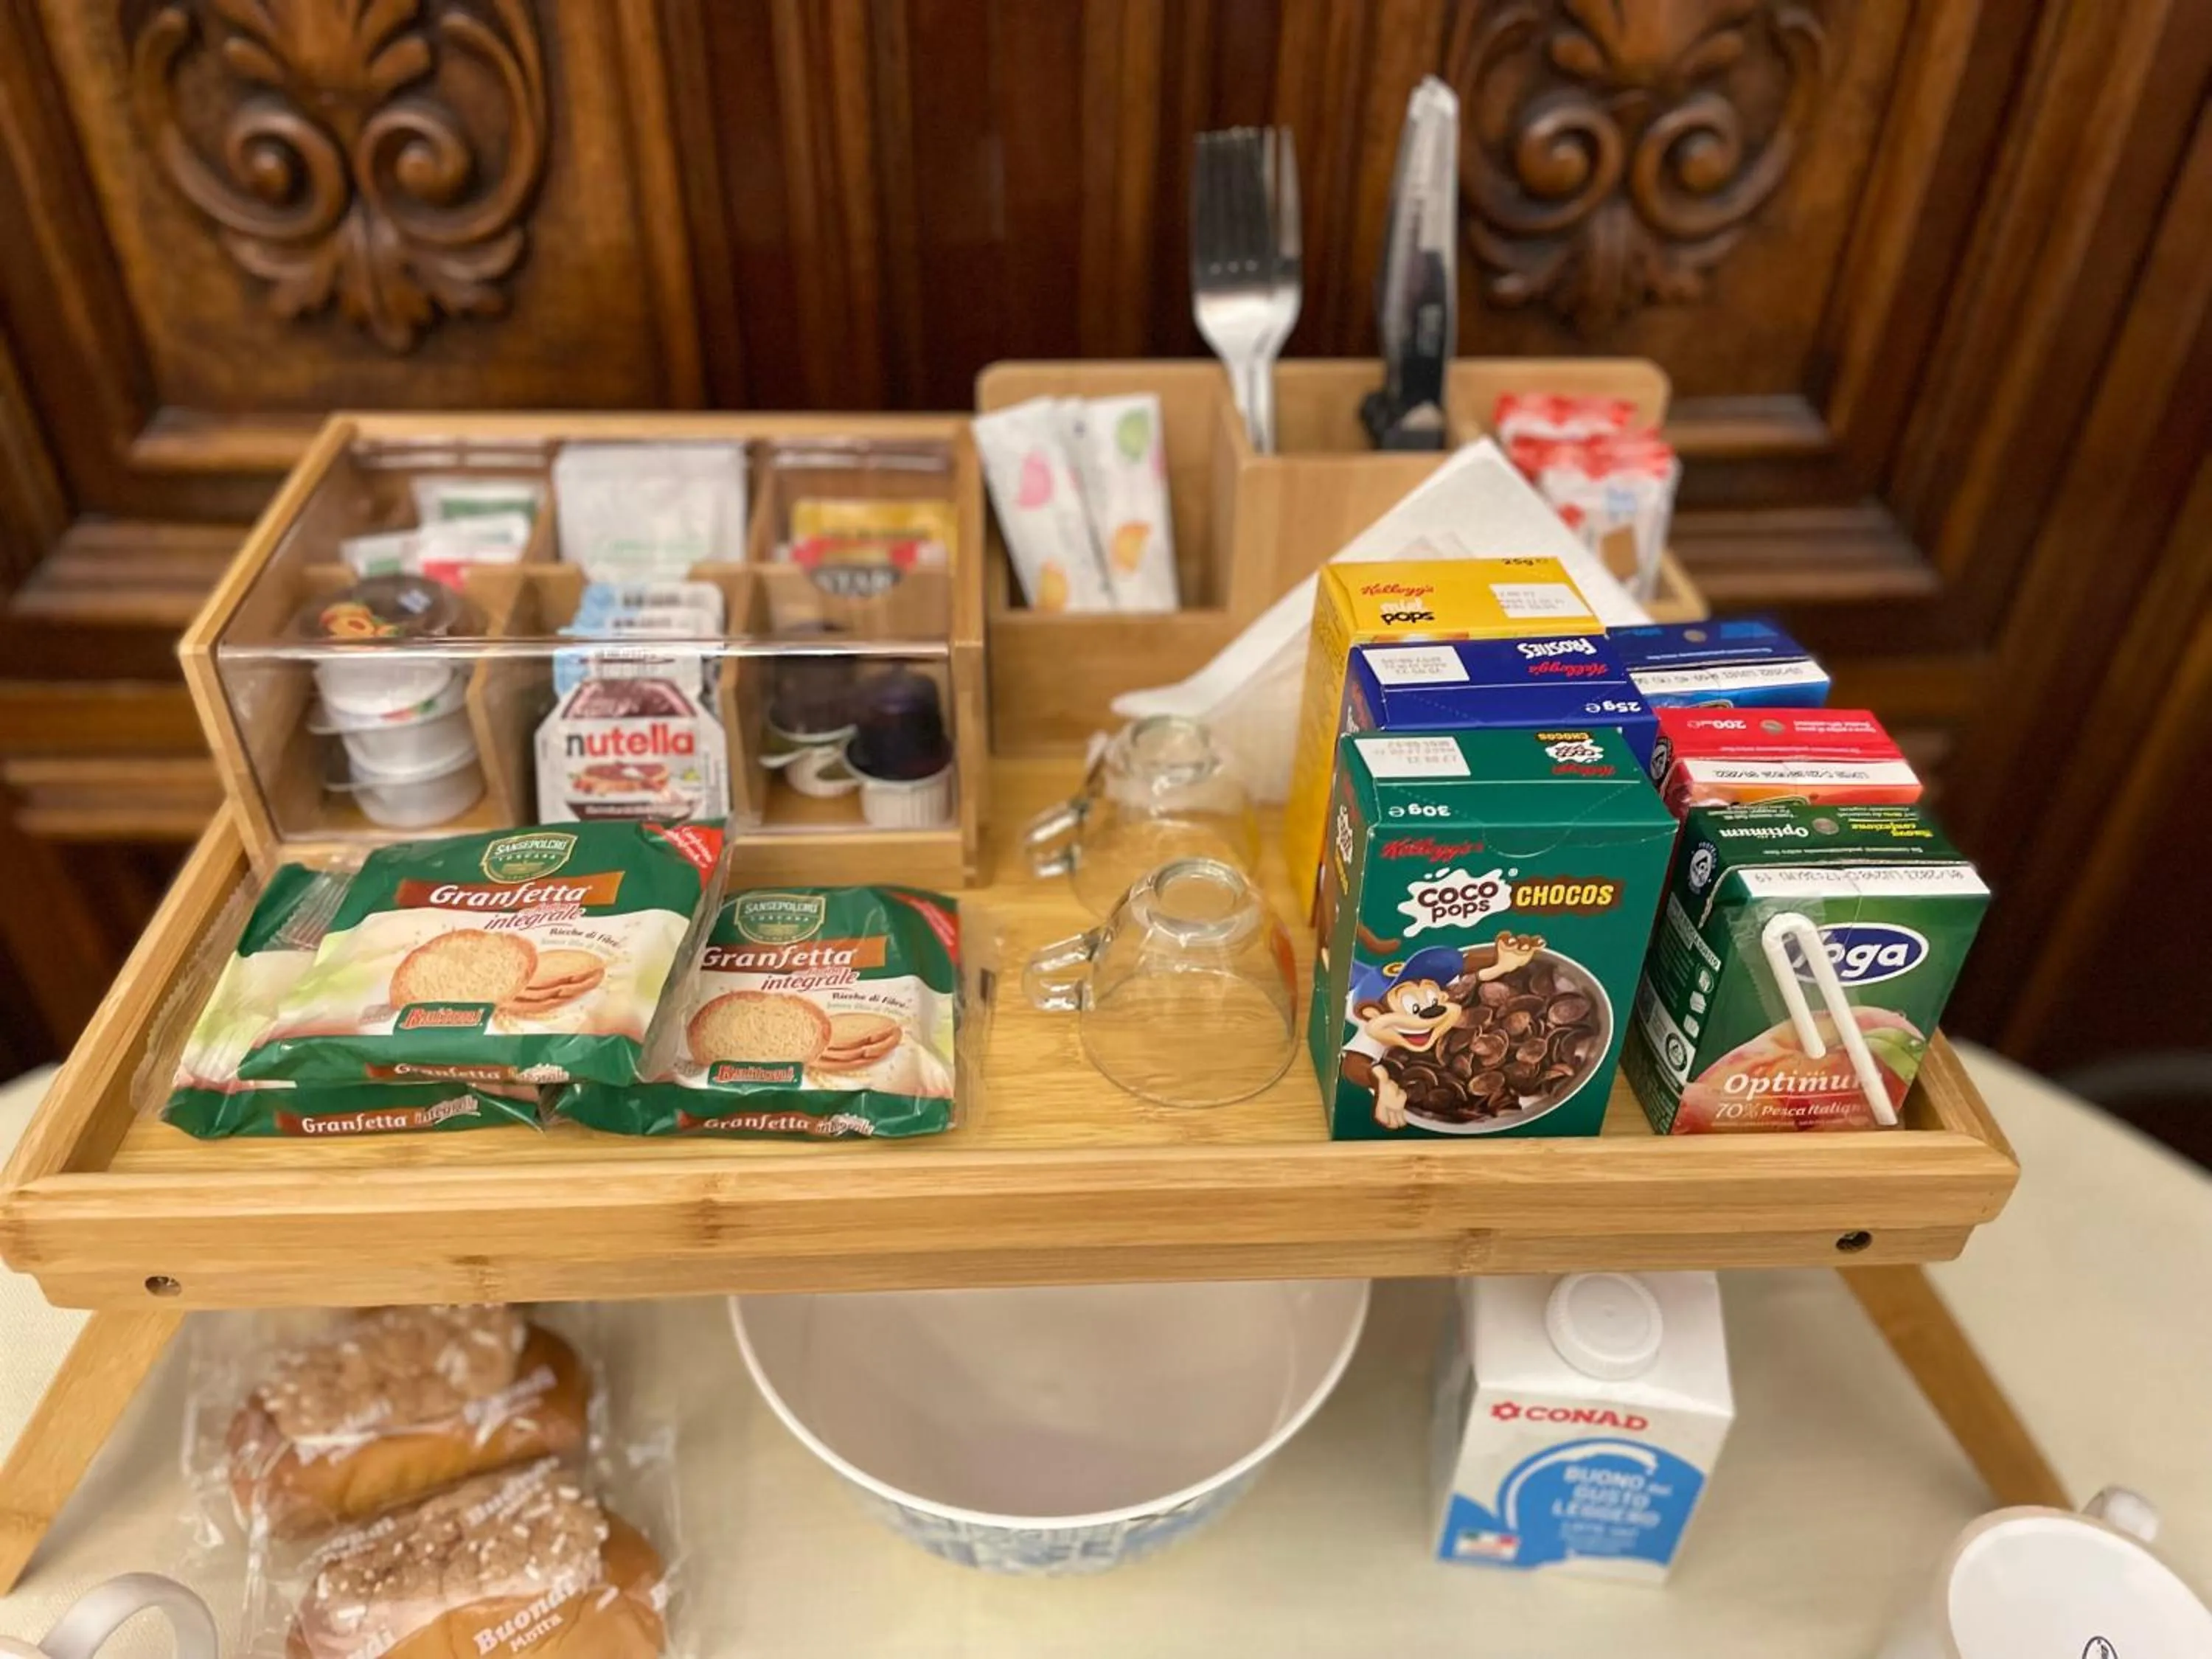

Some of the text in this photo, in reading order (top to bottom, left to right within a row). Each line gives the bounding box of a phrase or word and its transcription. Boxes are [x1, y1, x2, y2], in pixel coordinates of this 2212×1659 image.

[1360, 583, 1434, 597] Kellogg's
[1380, 611, 1436, 625] pops
[1517, 638, 1599, 658] FROSTIES
[1528, 663, 1609, 678] Kellogg's
[566, 723, 695, 758] nutella
[1537, 731, 1590, 740] CHOCOS
[1409, 804, 1451, 816] 30g
[1719, 824, 1809, 839] Optimum
[1380, 837, 1475, 862] Kellogg's
[429, 882, 588, 908] Granfetta
[1515, 884, 1614, 908] CHOCOS
[484, 902, 586, 931] integrale
[1431, 899, 1491, 923] pops
[701, 945, 855, 970] Granfetta
[760, 967, 860, 992] integrale
[1723, 1068, 1868, 1101] Optimu
[1762, 1105, 1806, 1116] Pesca
[302, 1113, 408, 1134] Granfetta
[703, 1114, 811, 1130] Granfetta
[1526, 1406, 1649, 1432] CONAD
